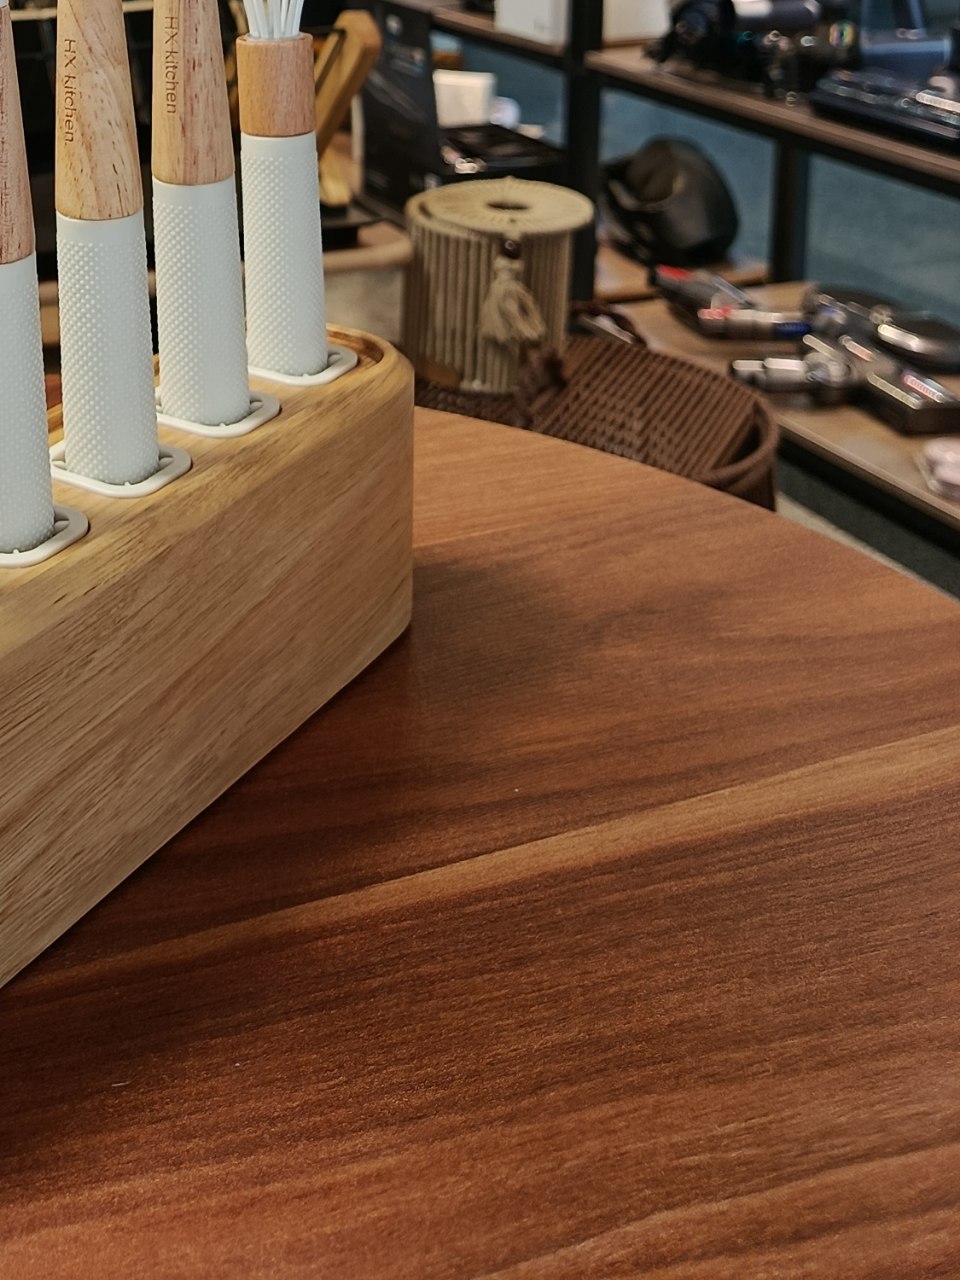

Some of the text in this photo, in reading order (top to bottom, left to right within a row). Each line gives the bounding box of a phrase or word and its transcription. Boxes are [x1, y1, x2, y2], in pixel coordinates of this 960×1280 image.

[64, 38, 77, 142] HX kitchen
[165, 50, 179, 114] kitchen
